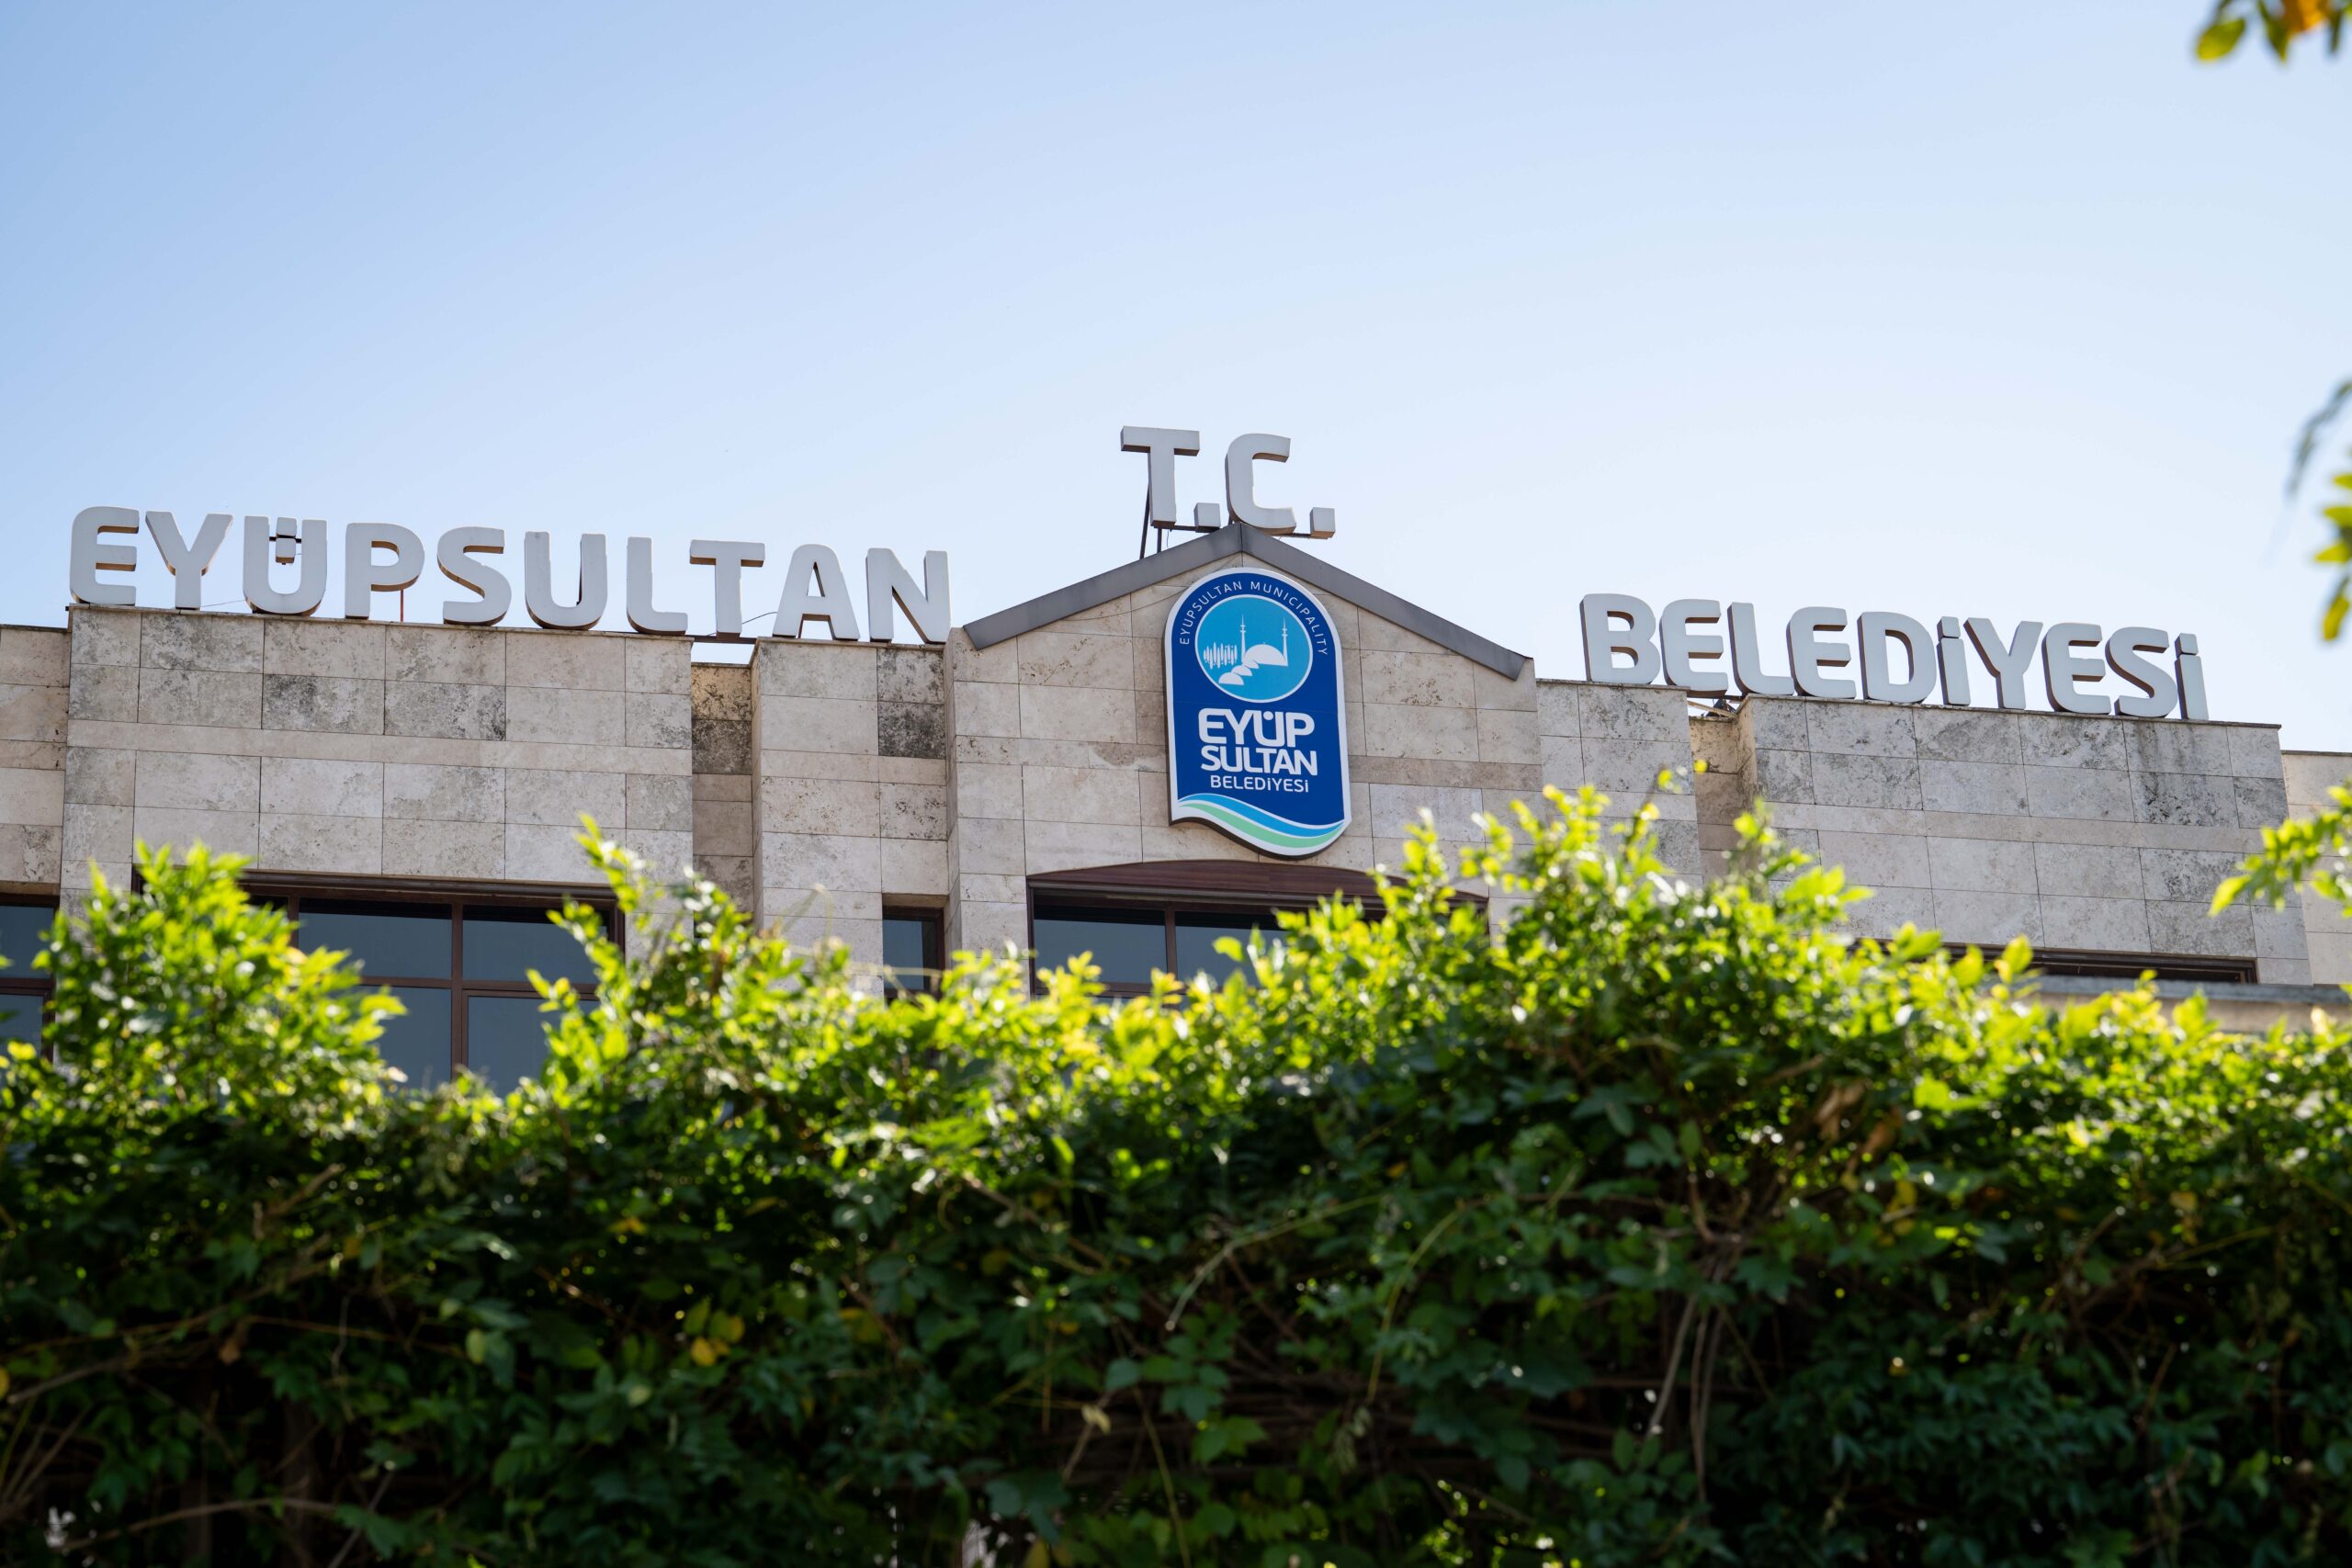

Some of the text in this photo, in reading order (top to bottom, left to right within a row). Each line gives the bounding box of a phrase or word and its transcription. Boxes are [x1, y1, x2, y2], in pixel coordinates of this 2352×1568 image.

[1121, 425, 1336, 539] T.C.
[69, 505, 952, 644] EYÜPSULTAN
[1180, 581, 1328, 655] EYUPSULTAN MUNICIPALITY
[1198, 708, 1315, 747] EYÜP
[1201, 746, 1317, 776] SULTAN
